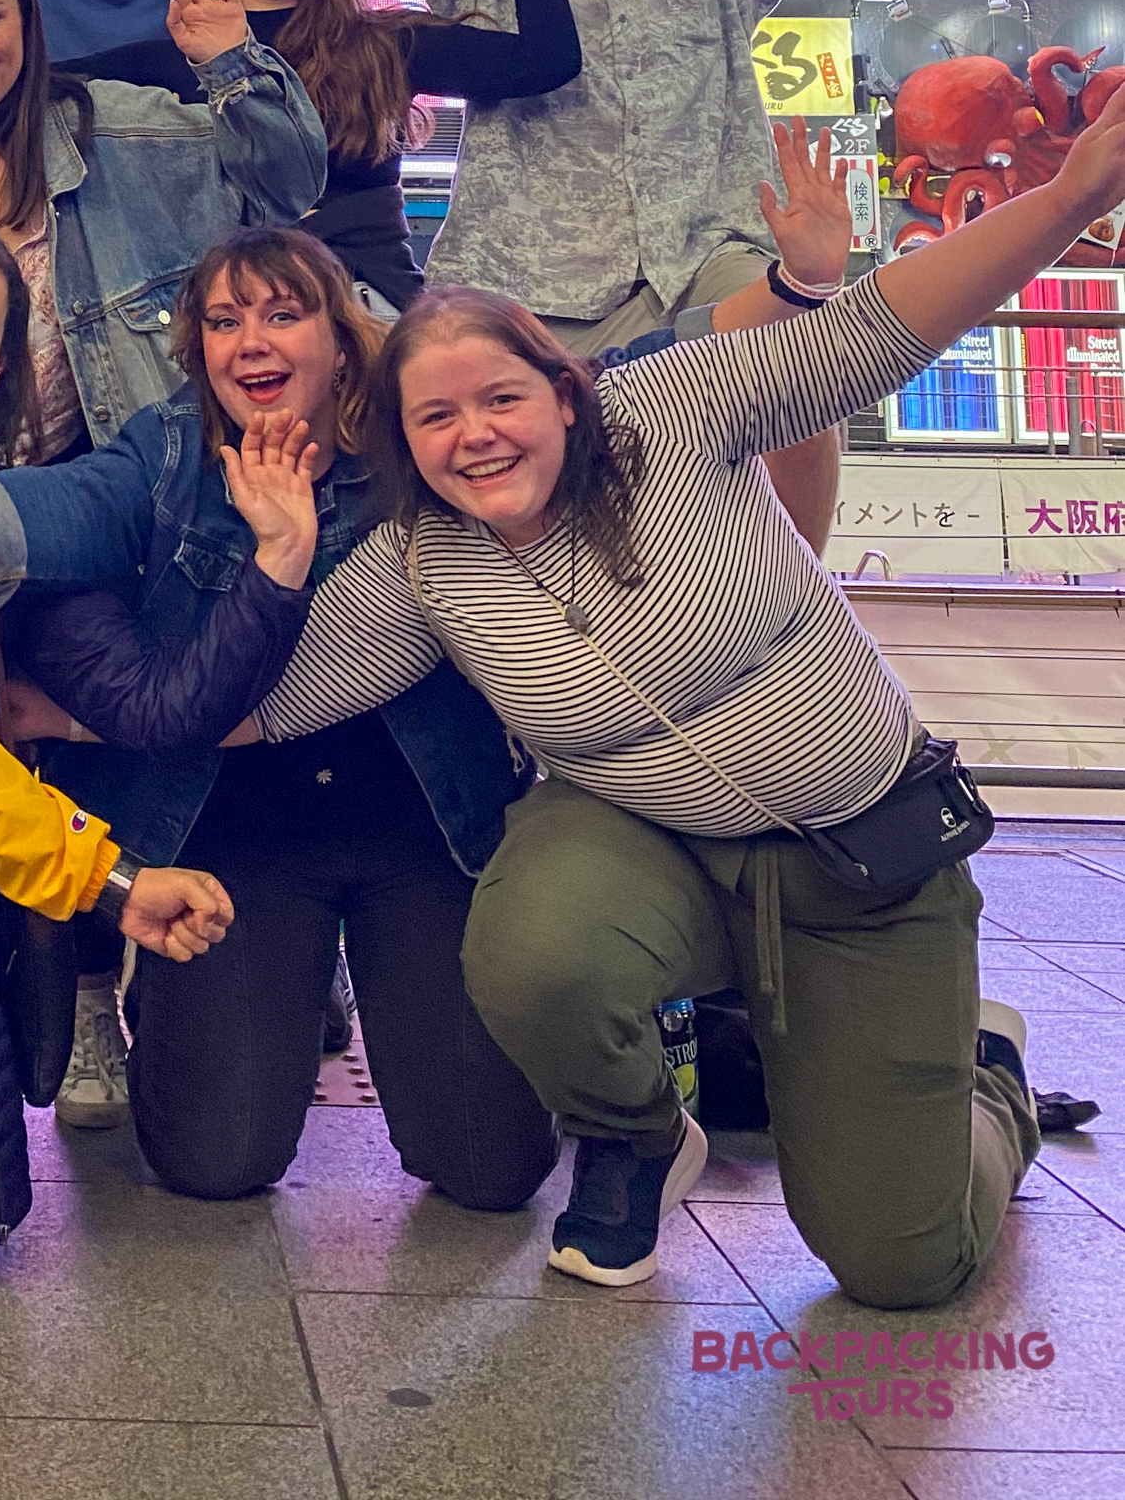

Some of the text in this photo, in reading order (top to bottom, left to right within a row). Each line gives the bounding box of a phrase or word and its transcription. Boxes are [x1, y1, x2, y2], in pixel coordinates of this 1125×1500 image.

[844, 139, 871, 155] 2F
[854, 181, 870, 222] 検索
[960, 336, 990, 347] Street
[1087, 336, 1117, 349] Street
